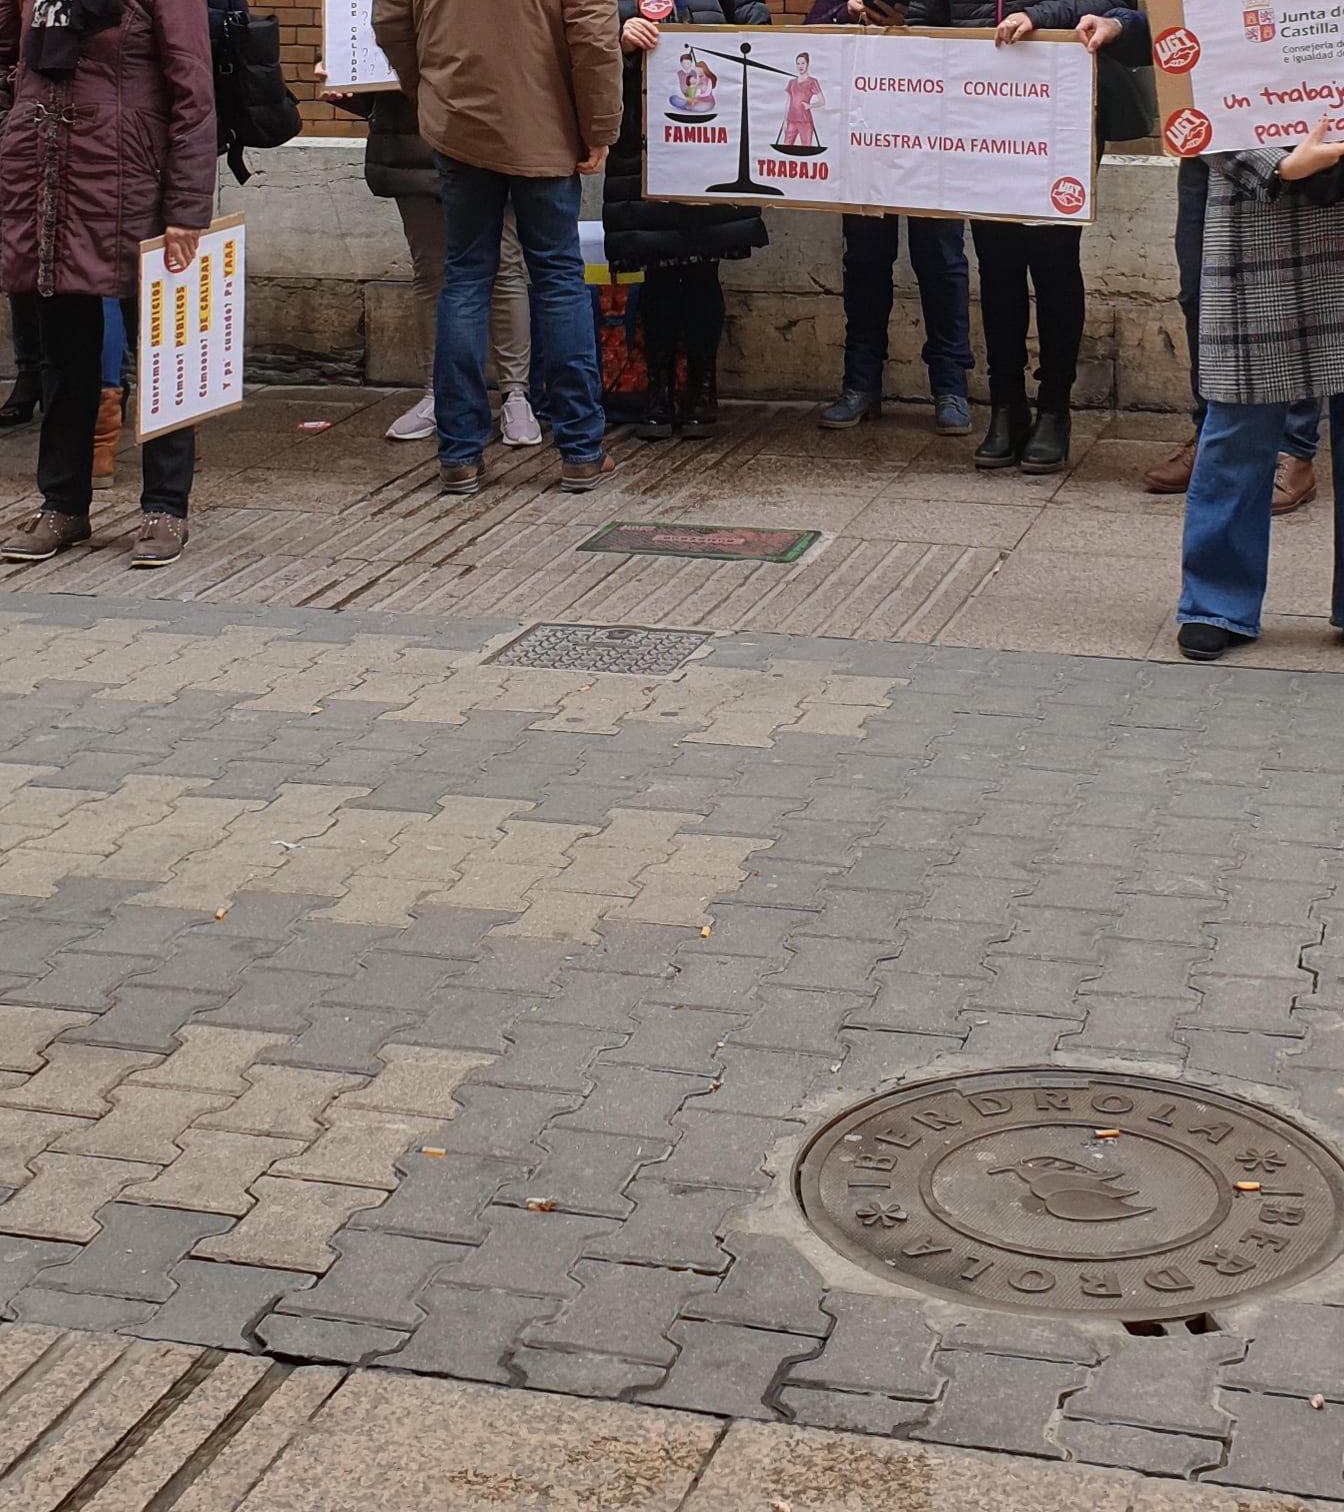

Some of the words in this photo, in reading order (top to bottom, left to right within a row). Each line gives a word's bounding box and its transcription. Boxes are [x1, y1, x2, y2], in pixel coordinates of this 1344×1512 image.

[1279, 10, 1325, 24] Junta
[1280, 22, 1339, 38] Castilla
[350, 26, 358, 82] CALIDAD
[1293, 50, 1333, 64] Igualdad
[854, 76, 945, 94] QUEREMOS
[963, 81, 1050, 98] CONCILIAR
[664, 125, 728, 144] FAMILIA
[850, 132, 922, 150] NUESTRA
[927, 136, 965, 152] VIDA
[970, 138, 1048, 156] FAMILIAR
[1254, 120, 1309, 144] para
[757, 159, 829, 181] TRABAJO
[200, 255, 209, 311] CALIDAD
[151, 281, 160, 348] SERVICIOS
[151, 352, 160, 414] Queremos
[848, 1090, 1234, 1191] IBERDROLA
[901, 1190, 1306, 1299] IBERDROLA
